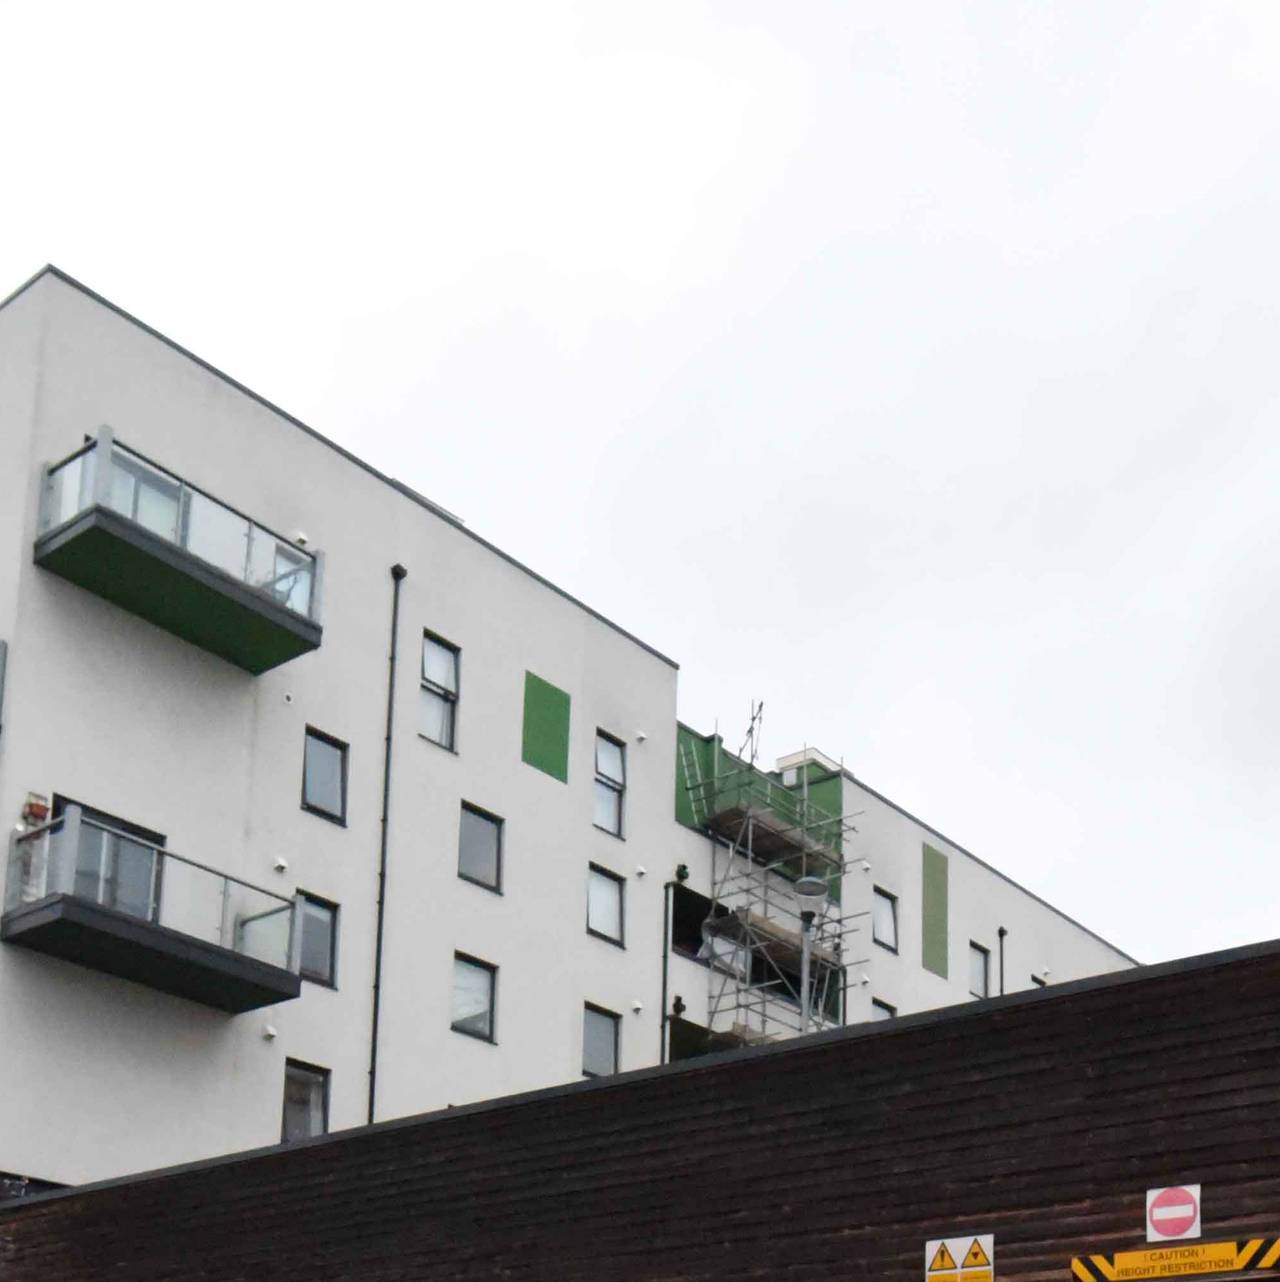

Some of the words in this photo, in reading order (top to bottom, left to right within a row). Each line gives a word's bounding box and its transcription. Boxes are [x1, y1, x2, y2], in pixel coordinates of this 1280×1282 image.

[1149, 1247, 1199, 1262] CAUTION
[1116, 1264, 1156, 1278] HEIGHT
[1159, 1257, 1235, 1274] RESTRICTION
